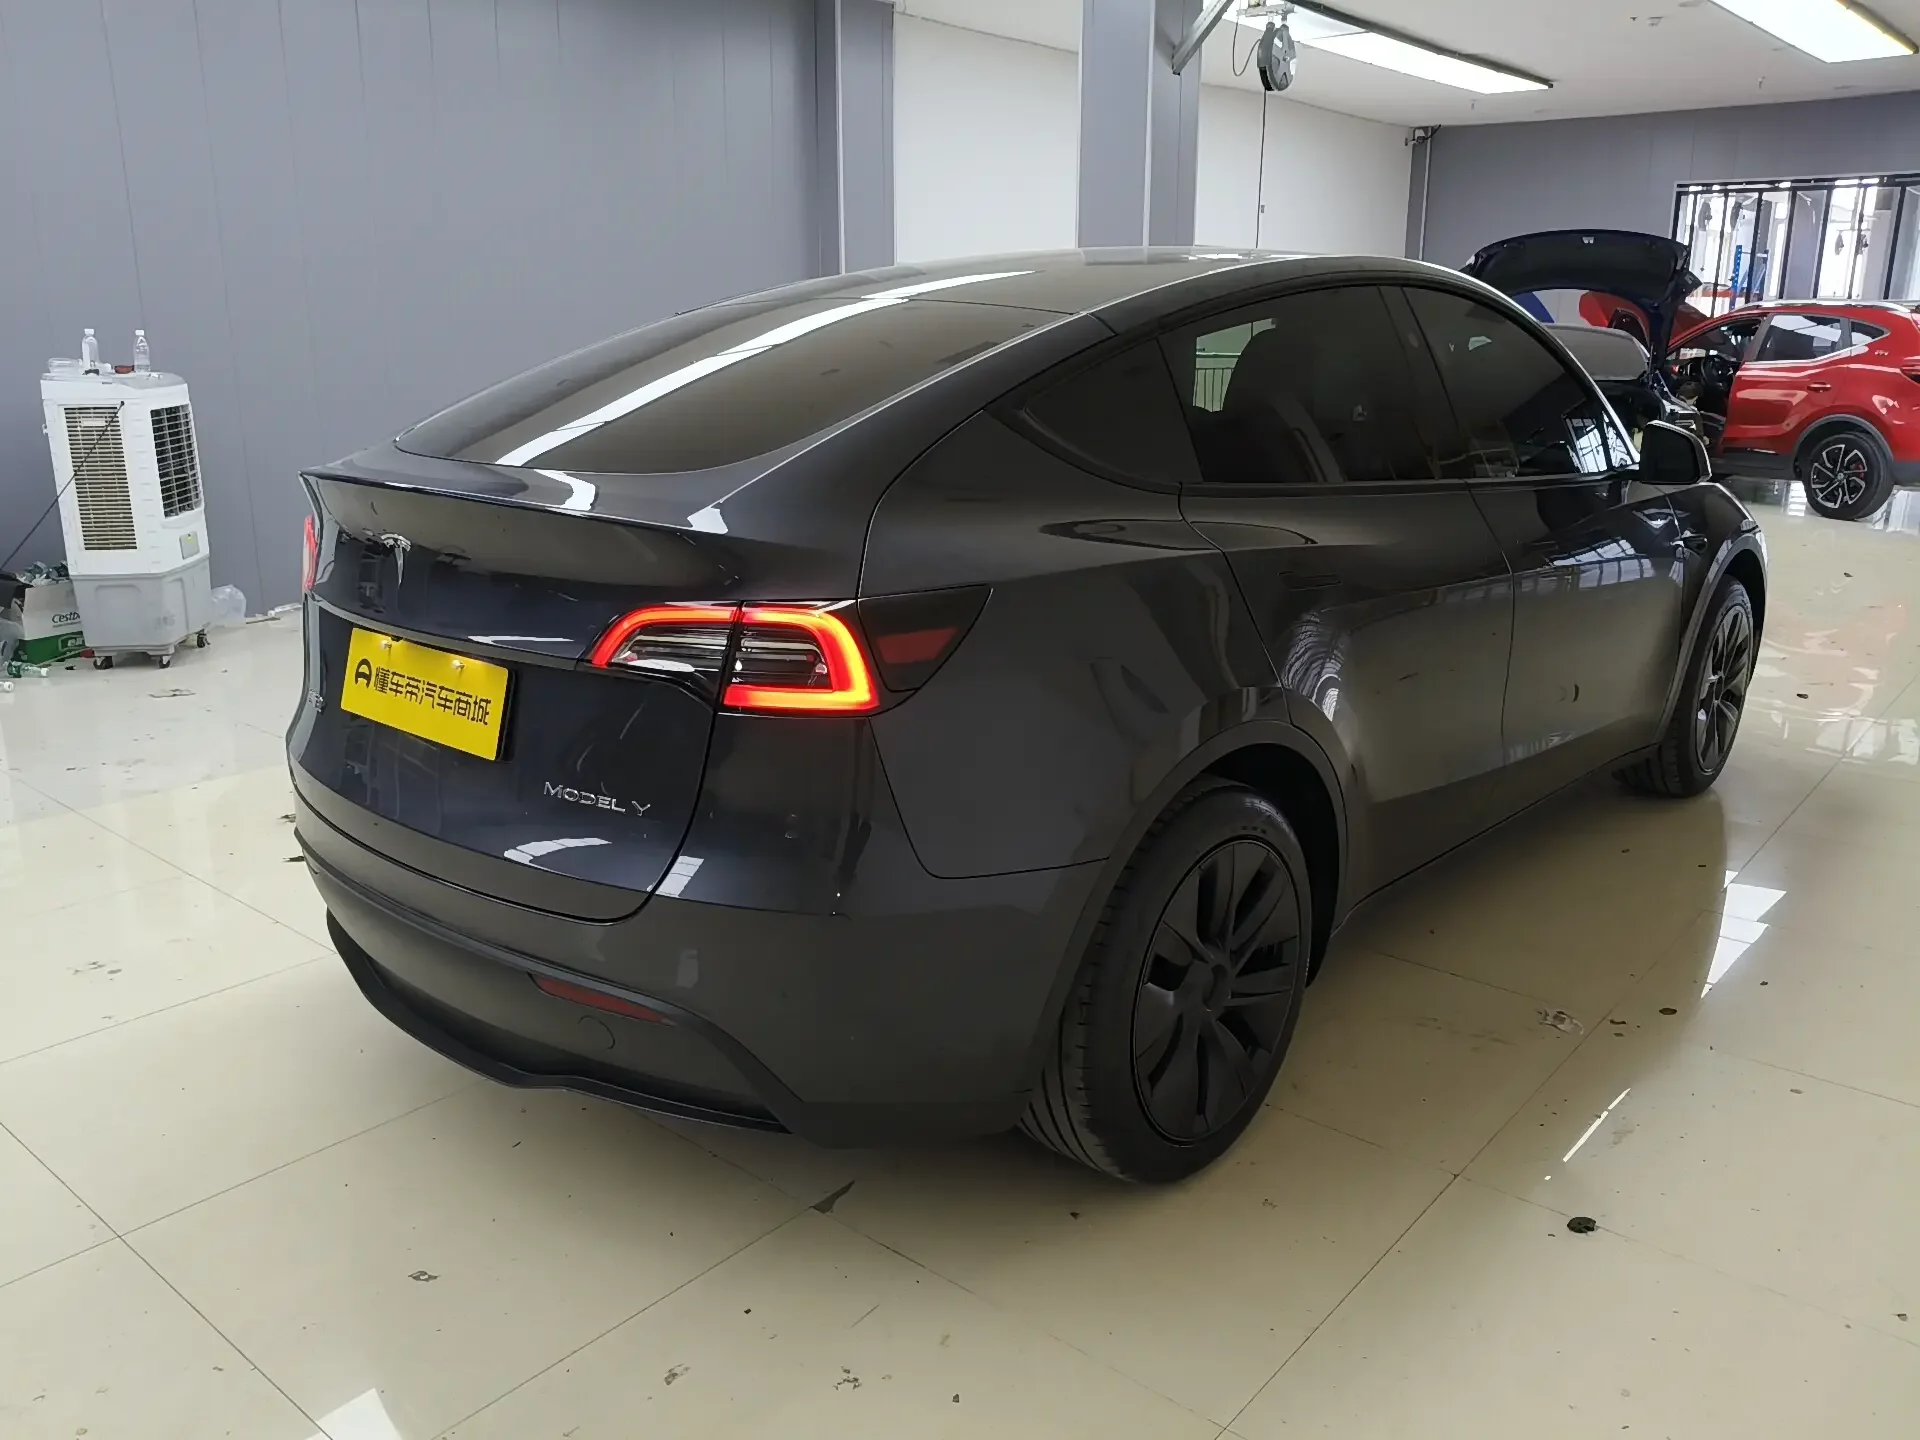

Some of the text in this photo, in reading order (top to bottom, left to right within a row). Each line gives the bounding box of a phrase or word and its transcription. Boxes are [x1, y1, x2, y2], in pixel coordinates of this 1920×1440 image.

[374, 665, 492, 725] 懂车帝汽车商城
[543, 781, 651, 816] MODEL Y
